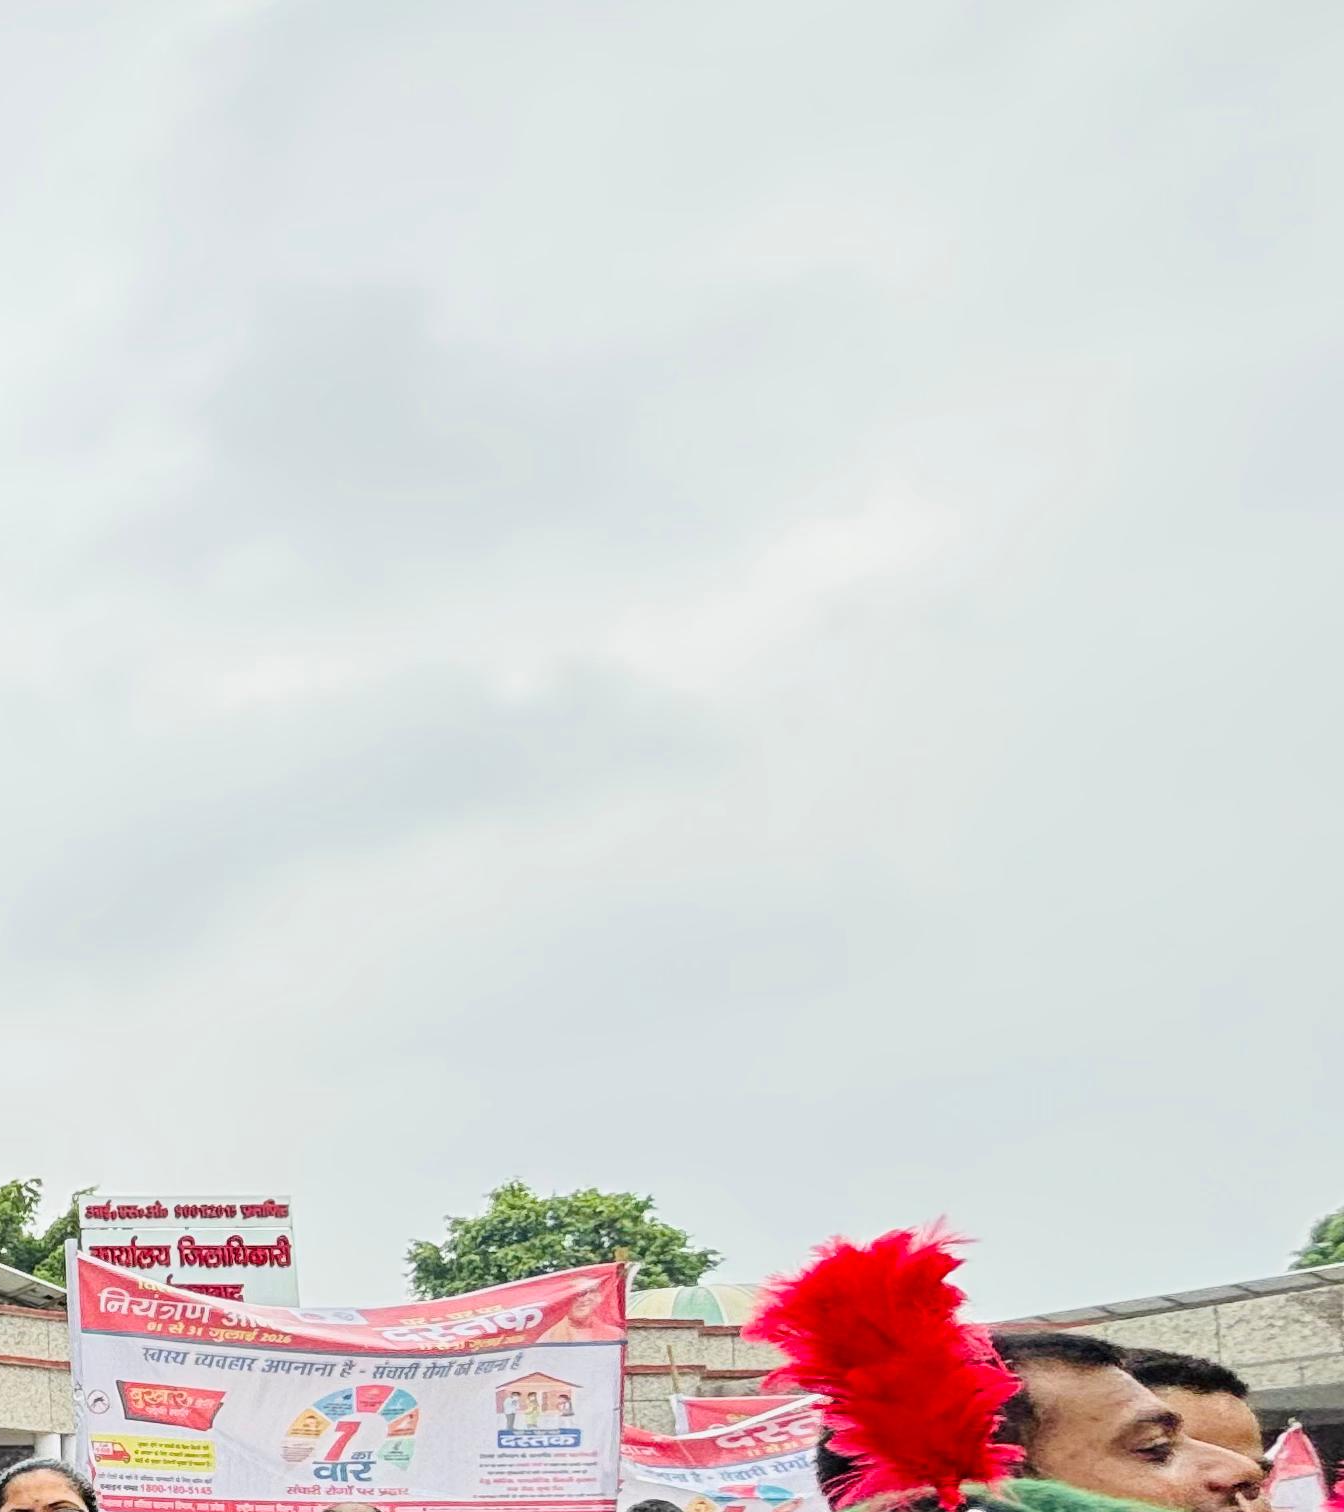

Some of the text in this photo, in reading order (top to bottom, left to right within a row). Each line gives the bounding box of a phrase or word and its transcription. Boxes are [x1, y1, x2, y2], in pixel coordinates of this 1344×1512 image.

[97, 1286, 212, 1324] नियंत्रण
[261, 1358, 336, 1378] अपनाना
[340, 1360, 357, 1378] है
[324, 1421, 361, 1461] 7
[312, 1461, 376, 1483] वार
